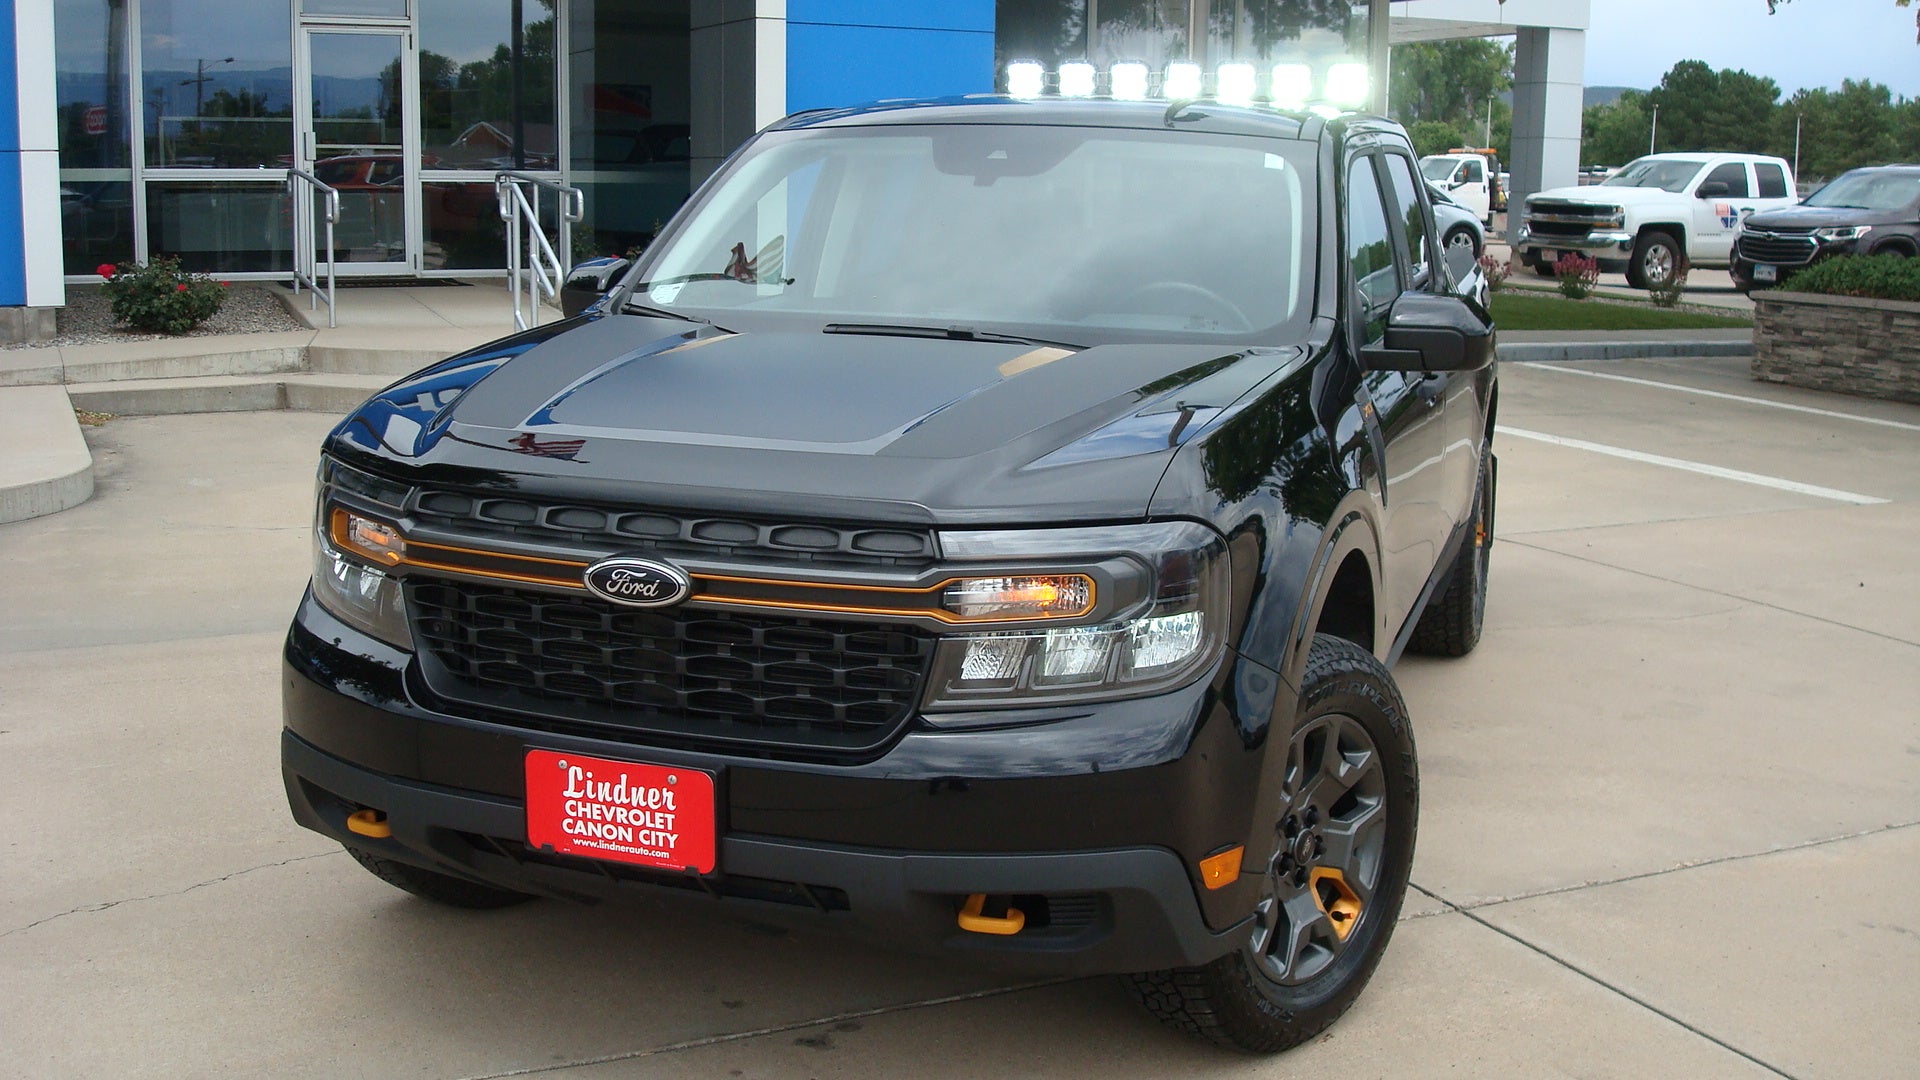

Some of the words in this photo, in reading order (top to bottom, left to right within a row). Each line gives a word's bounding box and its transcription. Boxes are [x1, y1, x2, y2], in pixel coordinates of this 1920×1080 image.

[605, 568, 661, 597] Ford
[562, 765, 677, 811] Lindner
[564, 799, 676, 831] CHEVROLET
[561, 818, 633, 843] CANON
[638, 829, 679, 849] CITY
[572, 837, 670, 859] www.lindnerauto.com
